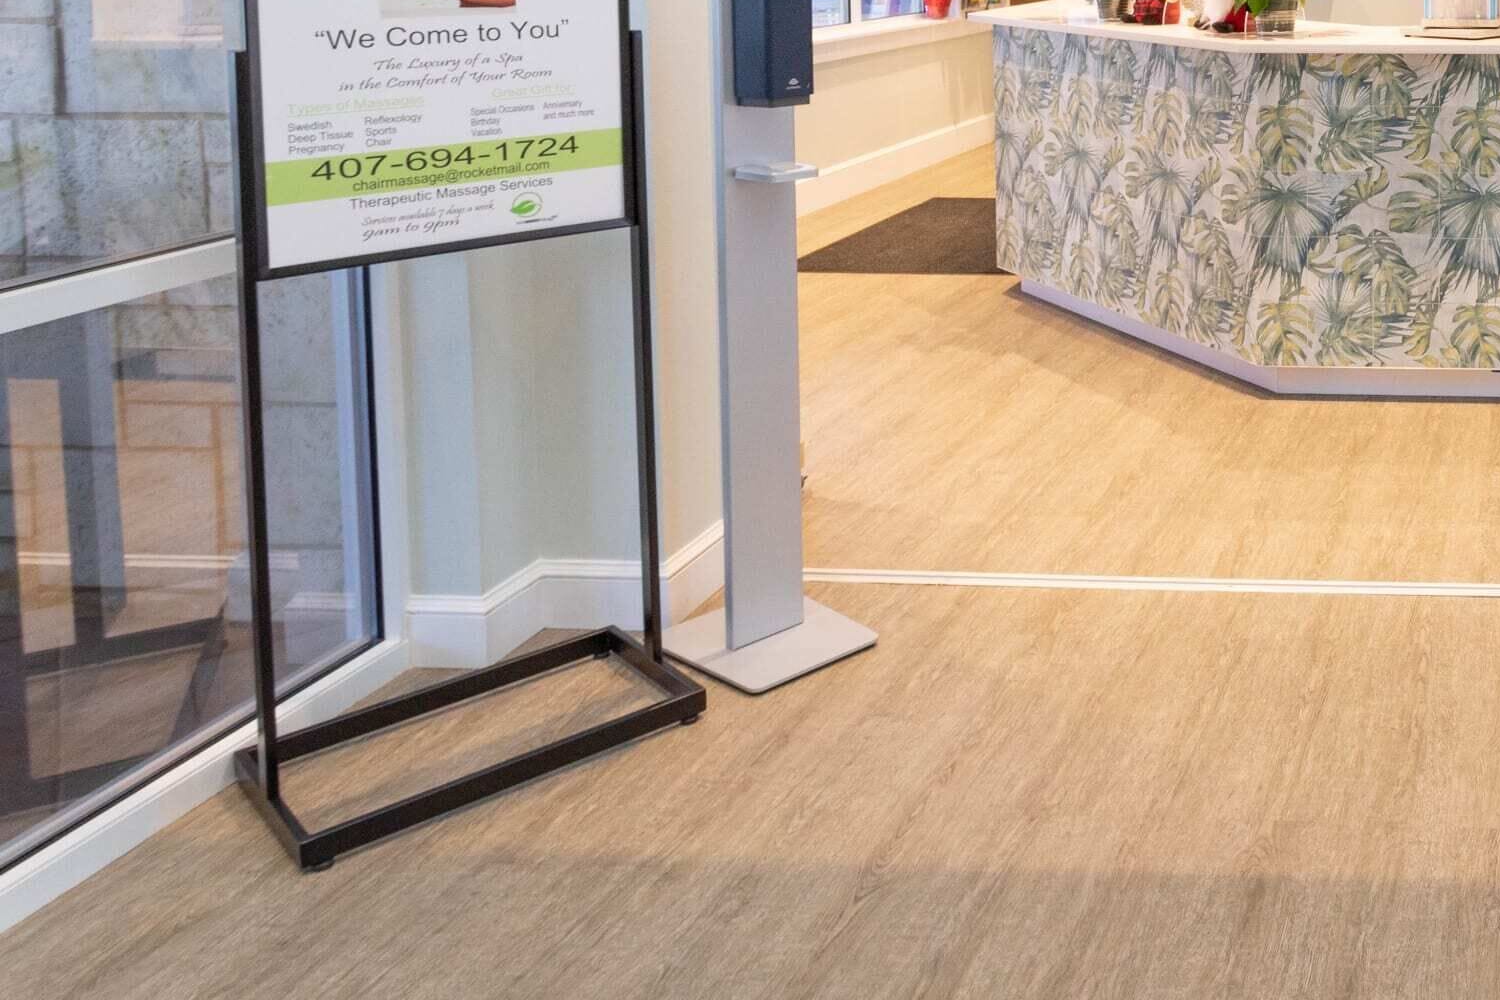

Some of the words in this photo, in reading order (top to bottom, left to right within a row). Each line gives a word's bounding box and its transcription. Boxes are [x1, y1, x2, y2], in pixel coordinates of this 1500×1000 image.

[314, 28, 375, 49] “We
[386, 26, 468, 46] Come
[478, 23, 501, 42] to
[511, 19, 569, 39] You”
[373, 56, 402, 71] The
[408, 54, 461, 72] Luxury
[464, 52, 480, 67] of
[495, 52, 523, 67] Spa
[338, 81, 354, 92] in
[359, 77, 382, 90] the
[386, 74, 448, 89] Comfort
[450, 71, 464, 87] of
[468, 70, 507, 84] Your
[510, 67, 553, 80] Room
[287, 103, 332, 117] Types
[335, 99, 350, 111] of
[353, 95, 425, 109] Massages
[287, 121, 332, 132] Swedish
[364, 114, 423, 126] Reflexology
[287, 133, 317, 144] Deep
[320, 131, 354, 141] Tissue
[365, 126, 398, 137] Sports
[288, 142, 345, 155] Pregnancy
[365, 138, 392, 147] Chair
[311, 136, 580, 181] 407-694-1724
[352, 160, 550, 193] chairmassage@rocketmail.com
[350, 191, 433, 211] Therapeutic
[436, 183, 496, 201] Massage
[500, 176, 554, 191] Services
[362, 226, 400, 242] 9am
[405, 222, 420, 233] to
[423, 217, 460, 234] 9pm
